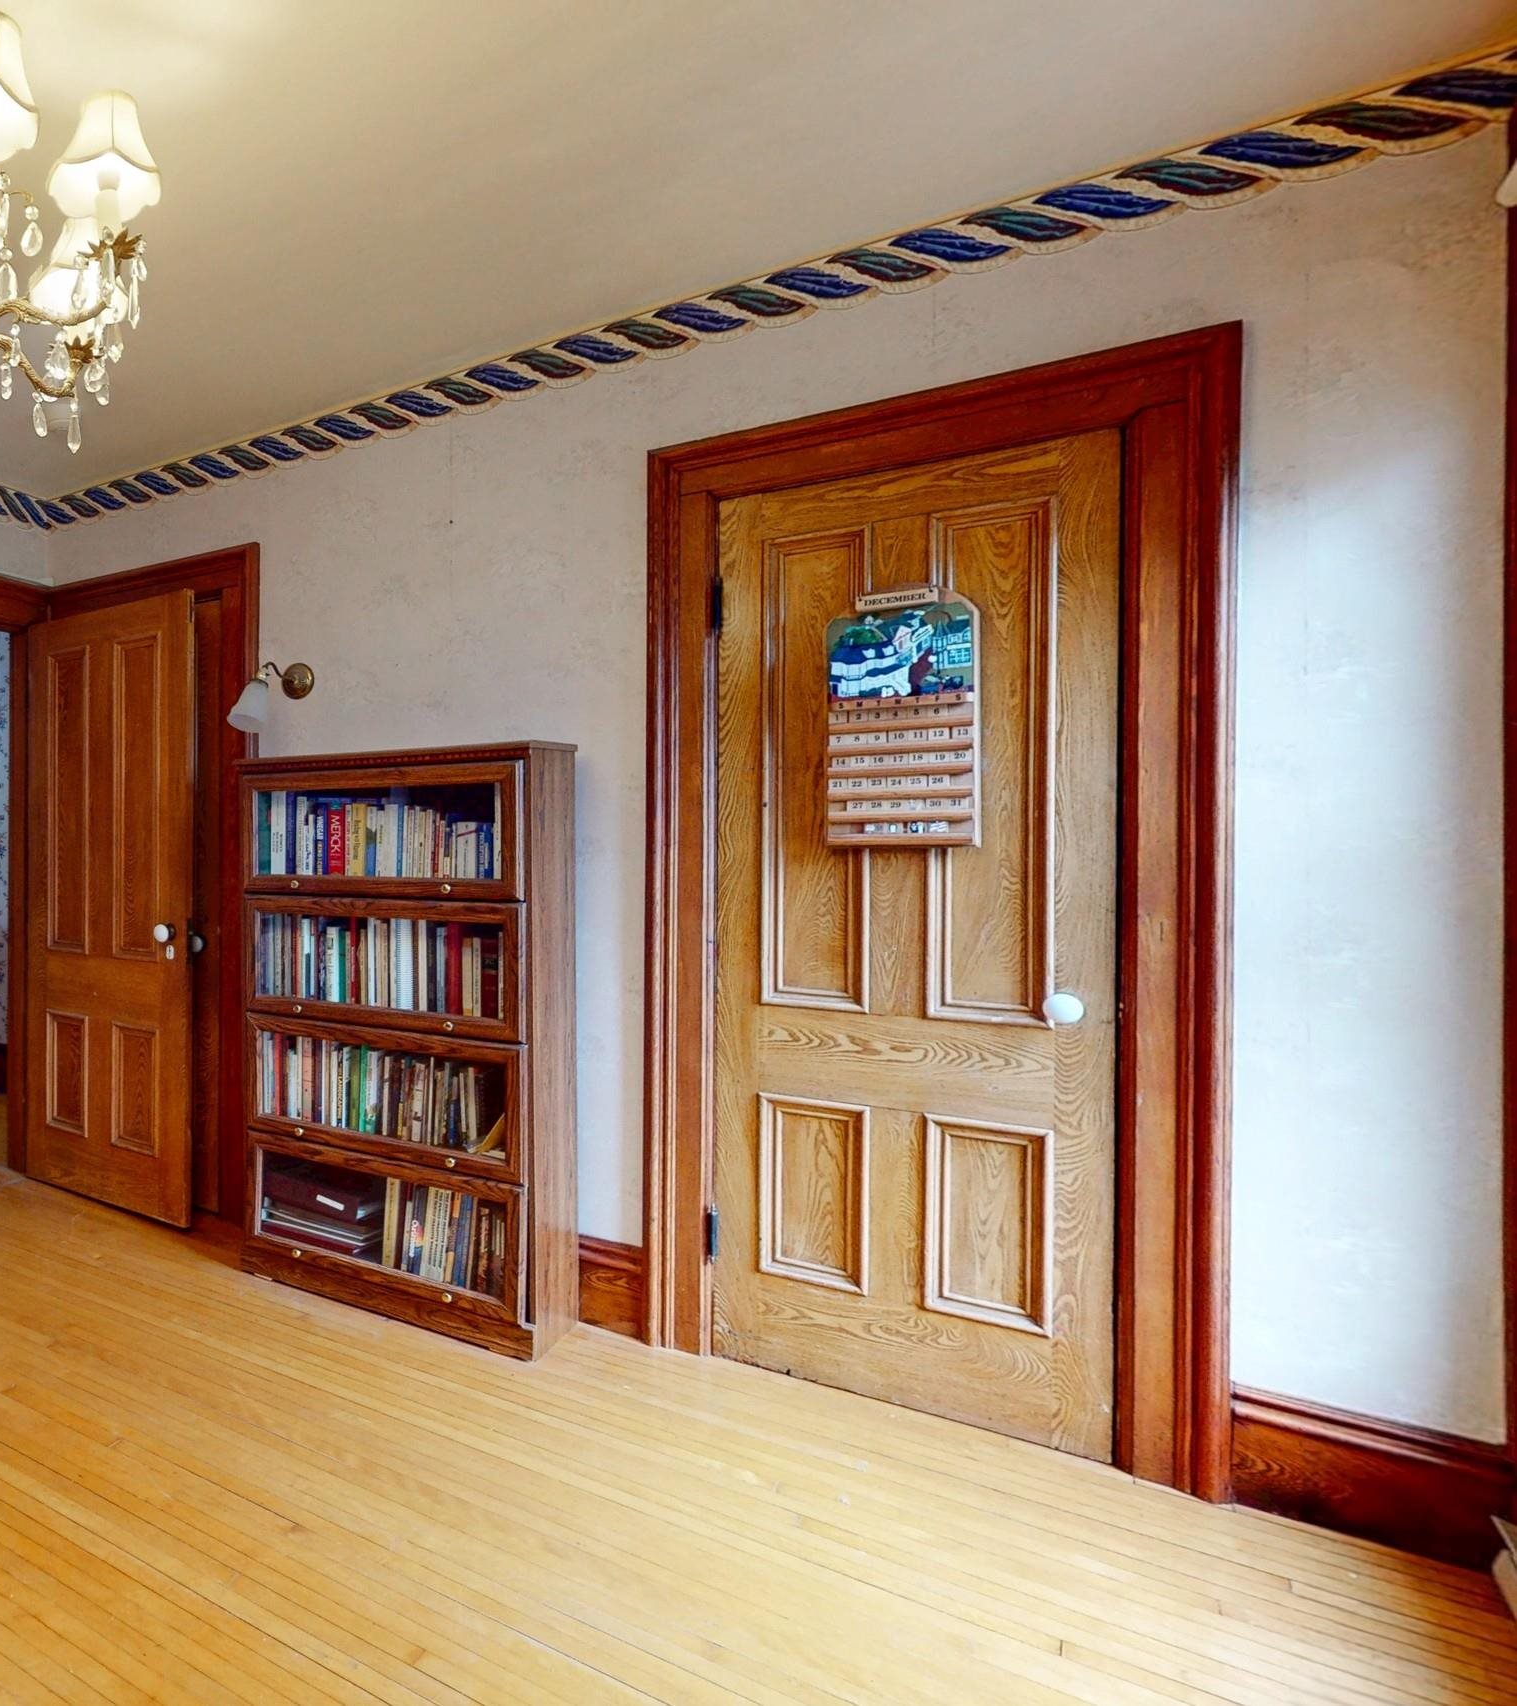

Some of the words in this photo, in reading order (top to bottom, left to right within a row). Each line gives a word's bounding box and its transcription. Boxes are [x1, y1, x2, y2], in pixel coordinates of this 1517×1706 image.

[864, 594, 925, 606] DECEMBER
[893, 732, 904, 740] 10
[913, 731, 924, 739] 11
[873, 756, 884, 764] 16
[893, 755, 904, 763] 17
[934, 753, 946, 761] 19
[316, 816, 324, 840] VINEGAR
[330, 815, 341, 852] MERCK
